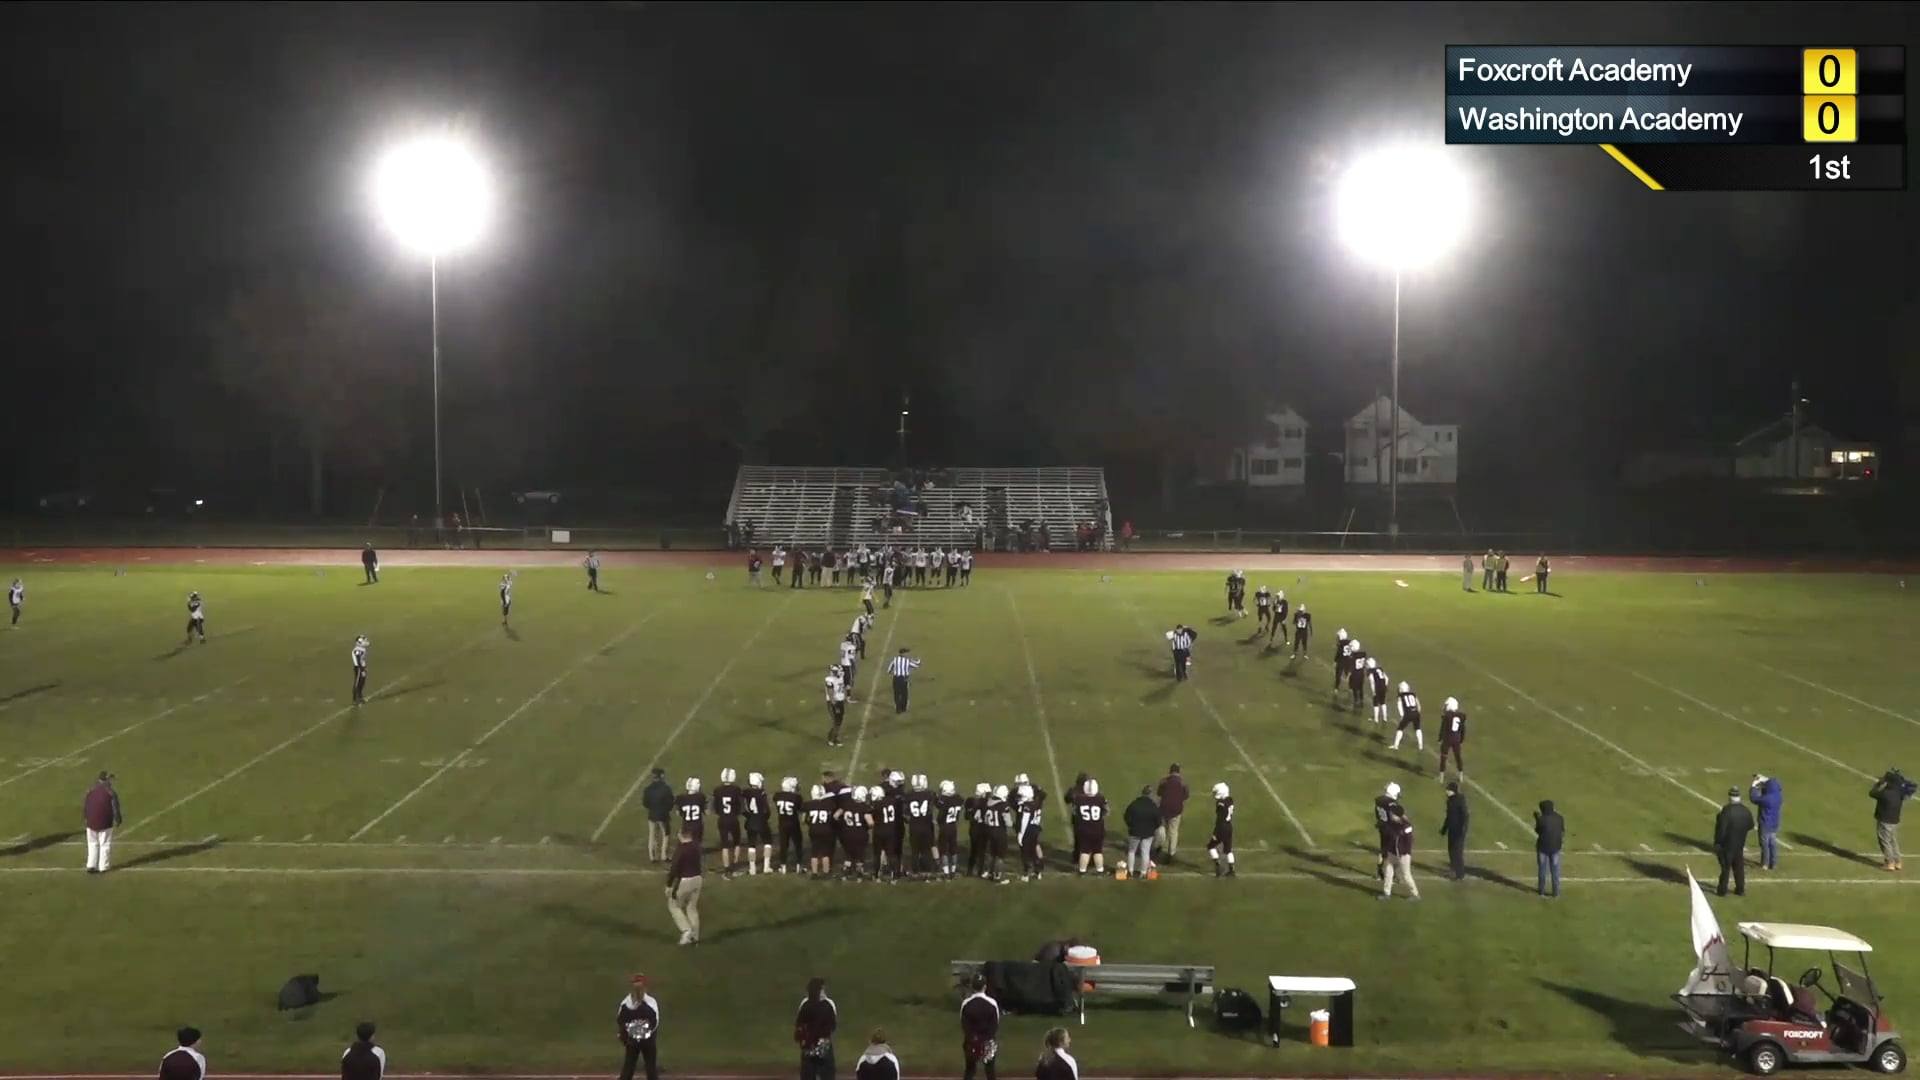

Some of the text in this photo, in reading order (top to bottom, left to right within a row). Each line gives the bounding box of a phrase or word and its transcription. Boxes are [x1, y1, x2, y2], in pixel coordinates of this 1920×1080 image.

[1404, 695, 1416, 707] 10
[1452, 717, 1460, 732] 6
[682, 805, 700, 821] 72
[722, 797, 731, 814] 5
[749, 797, 758, 814] 4
[777, 801, 794, 815] 75
[910, 800, 928, 817] 64
[1081, 805, 1101, 821] 58
[883, 805, 895, 823] 13
[1783, 1030, 1824, 1039] FOXCROFT
